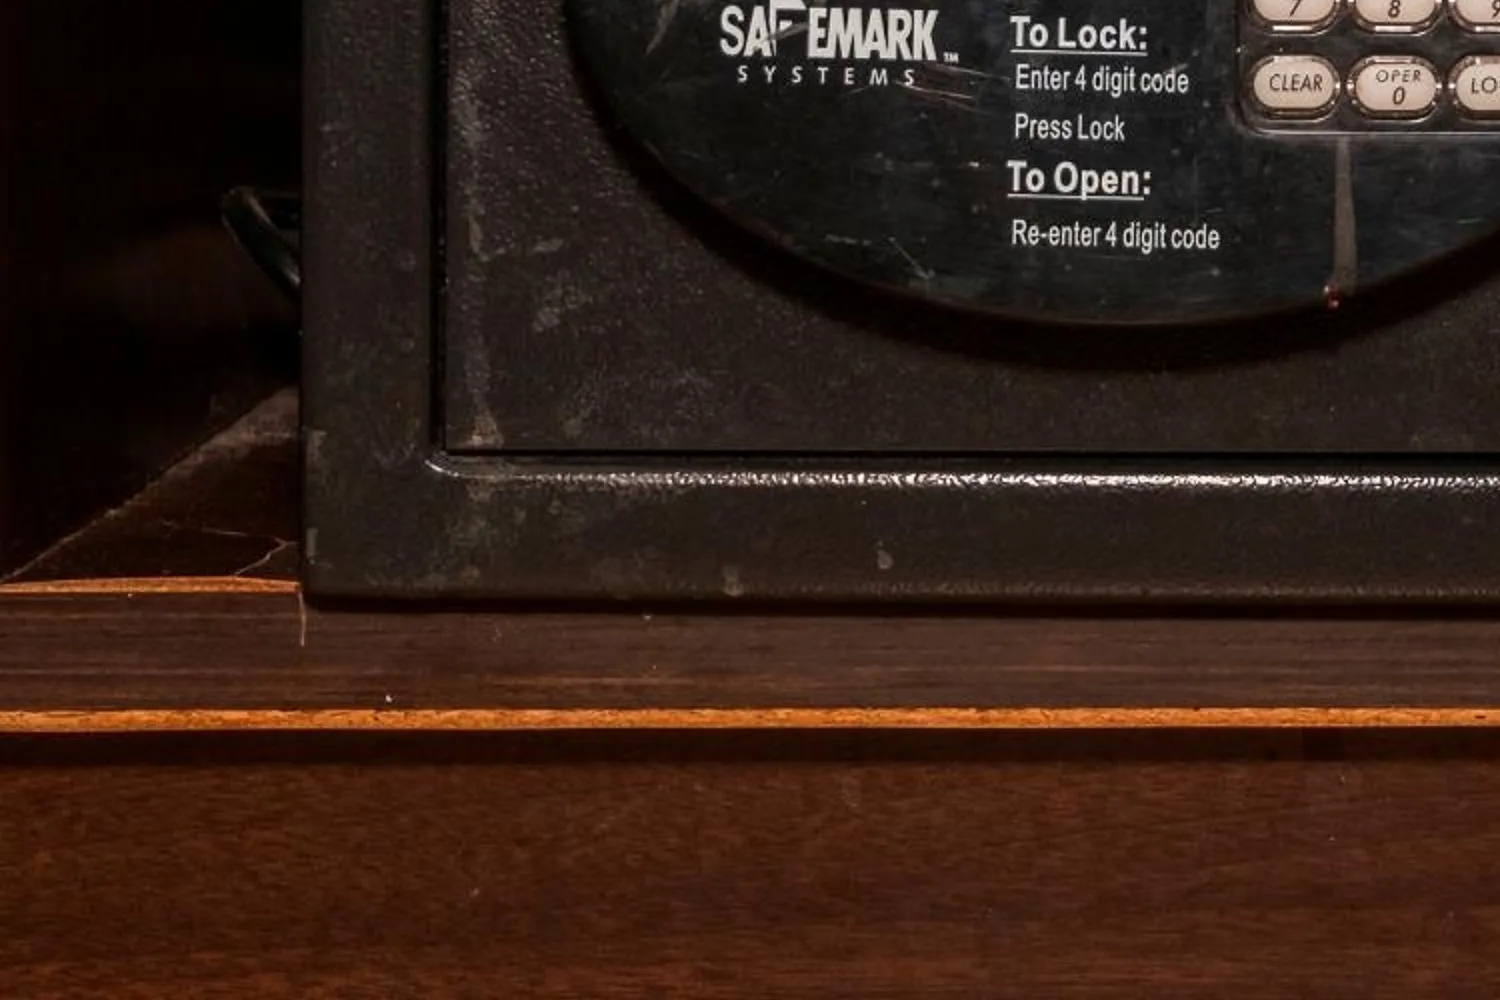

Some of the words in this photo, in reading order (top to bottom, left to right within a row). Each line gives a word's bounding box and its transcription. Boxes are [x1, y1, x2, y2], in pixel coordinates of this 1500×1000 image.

[1388, 0, 1401, 18] 8
[1010, 16, 1049, 49] To
[1058, 17, 1149, 50] Lock:
[737, 65, 915, 86] SYSTEMS
[1016, 64, 1070, 92] Enter
[1074, 65, 1086, 91] 4
[1092, 65, 1136, 98] digit
[1140, 65, 1189, 92] code
[1269, 74, 1323, 92] CLEAR
[1376, 70, 1421, 82] OPER
[1392, 87, 1406, 105] 0
[1014, 114, 1073, 140] Press
[1077, 114, 1125, 141] Lock
[1007, 160, 1045, 194] To
[1054, 161, 1151, 201] Open:
[1011, 220, 1101, 248] Re-enter
[1105, 222, 1117, 248] 4
[1123, 221, 1166, 254] digit
[1171, 222, 1221, 250] code
